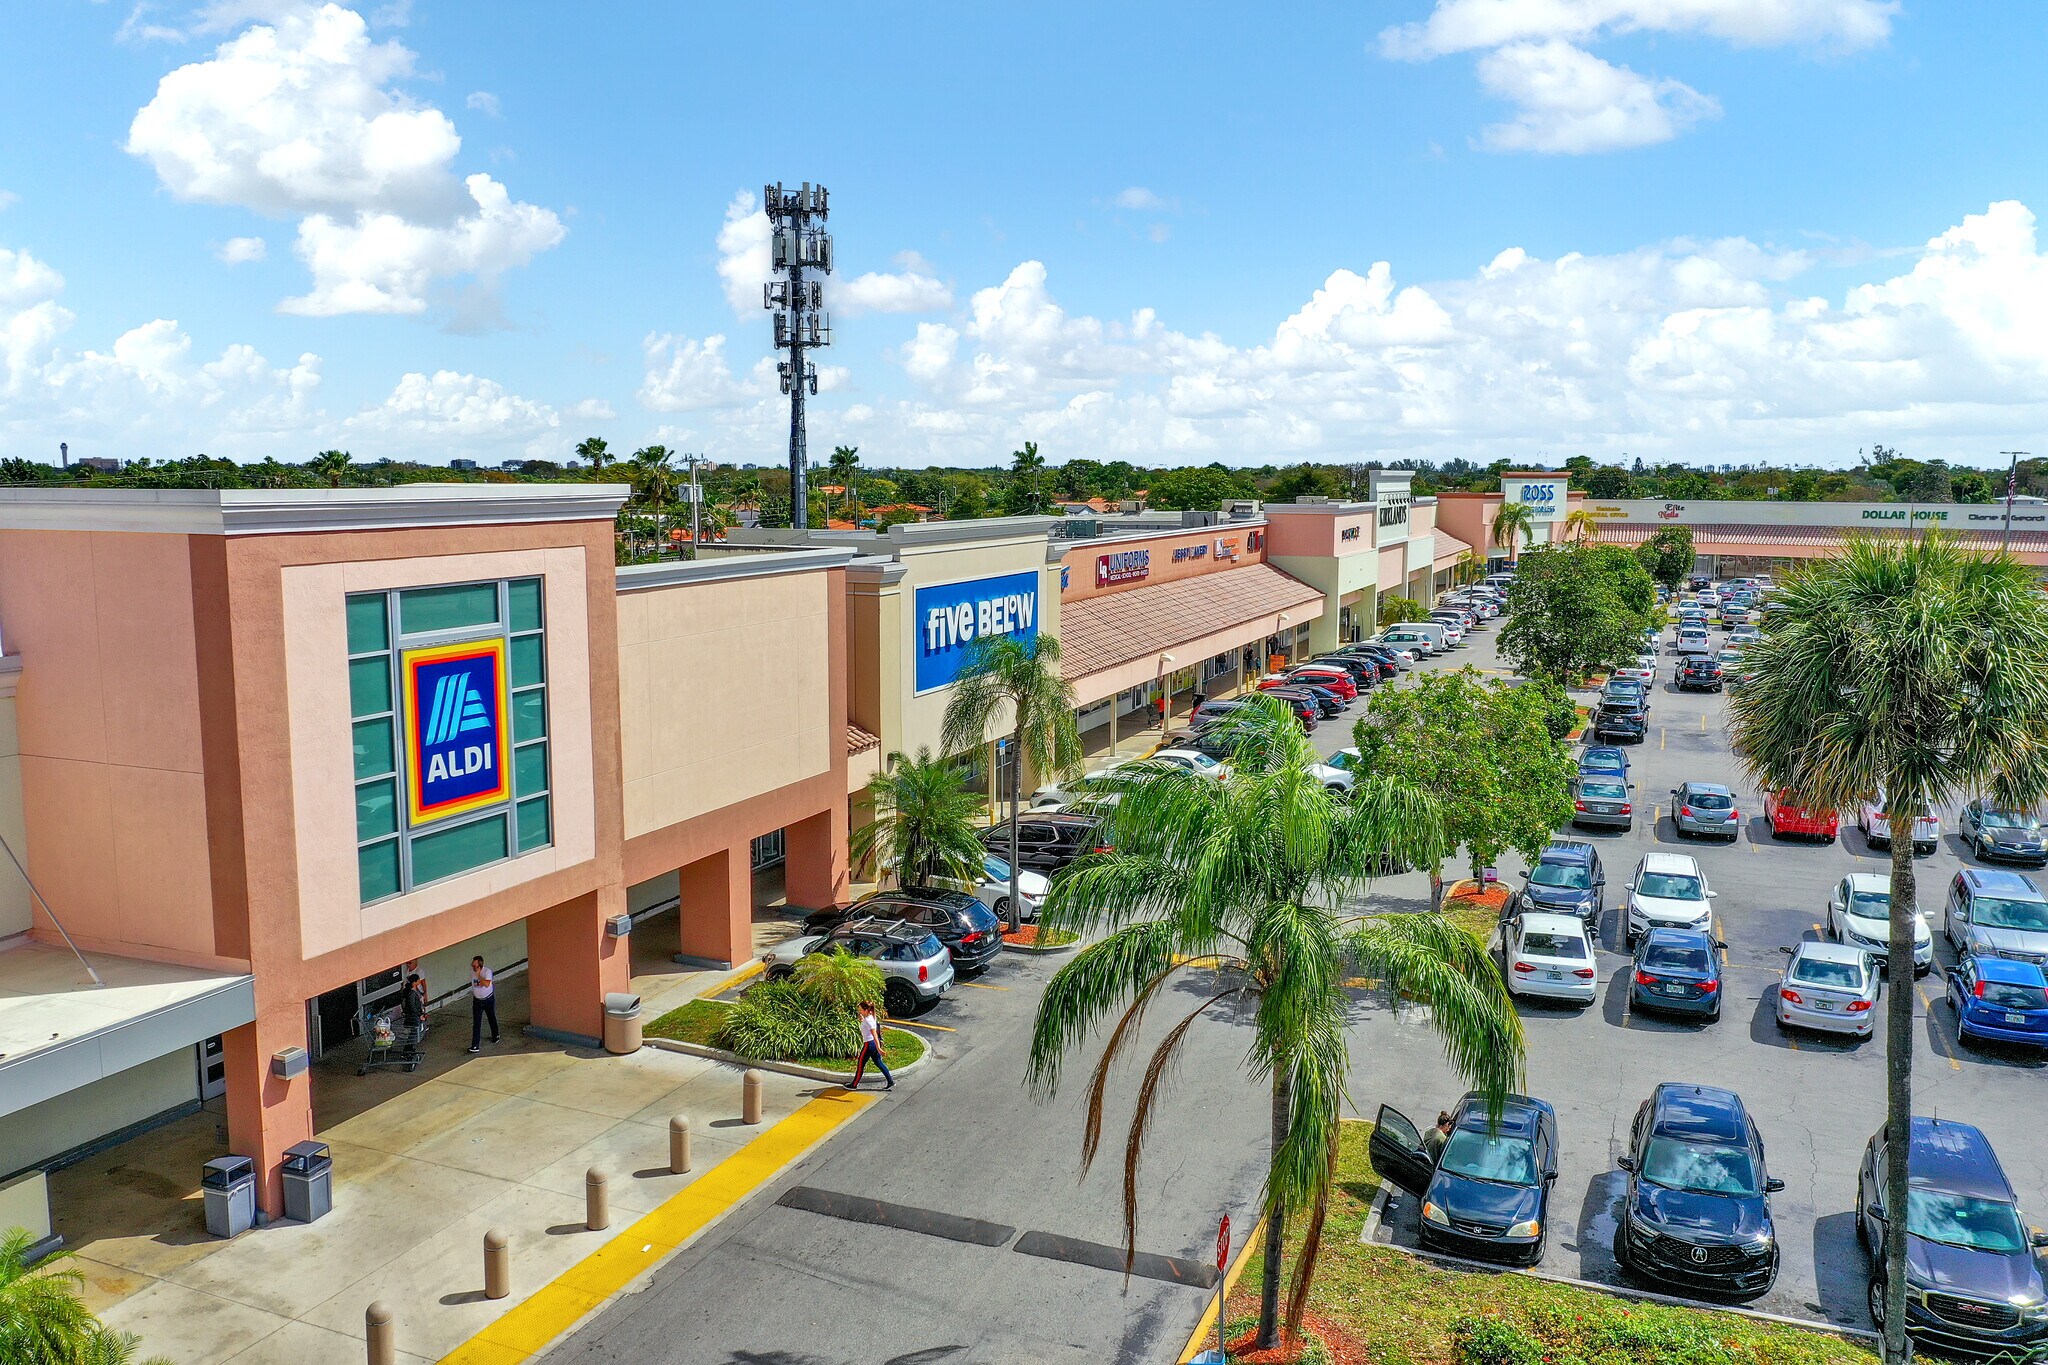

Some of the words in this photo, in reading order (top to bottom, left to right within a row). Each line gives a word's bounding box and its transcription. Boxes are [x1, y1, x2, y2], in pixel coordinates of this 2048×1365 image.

[1523, 484, 1554, 501] ROSS
[1862, 510, 1906, 520] DOLLAR
[1910, 511, 1948, 521] HOUSE
[1109, 549, 1149, 571] UNIFORMS
[928, 602, 974, 650] five
[427, 742, 492, 784] ALDI
[1217, 1225, 1229, 1262] STOP
